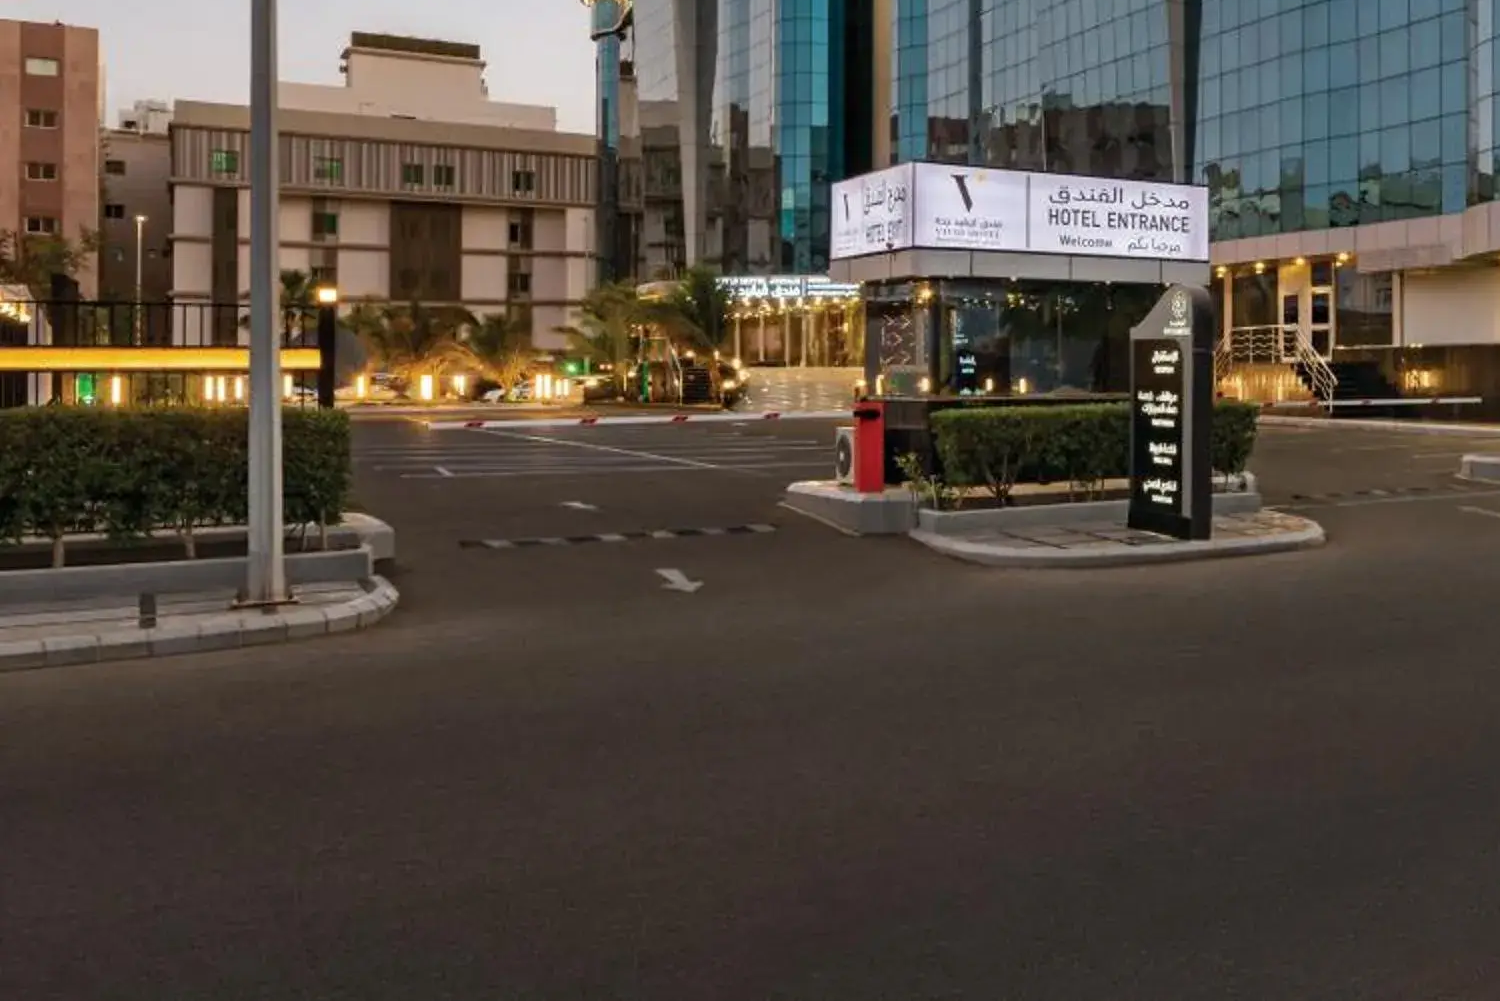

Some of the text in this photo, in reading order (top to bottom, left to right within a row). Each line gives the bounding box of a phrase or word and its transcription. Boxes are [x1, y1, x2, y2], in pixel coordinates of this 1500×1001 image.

[1049, 185, 1189, 210] مدخل الفندق
[1048, 209, 1191, 233] HOTEL ENTRANCE
[1059, 234, 1112, 248] Welcome
